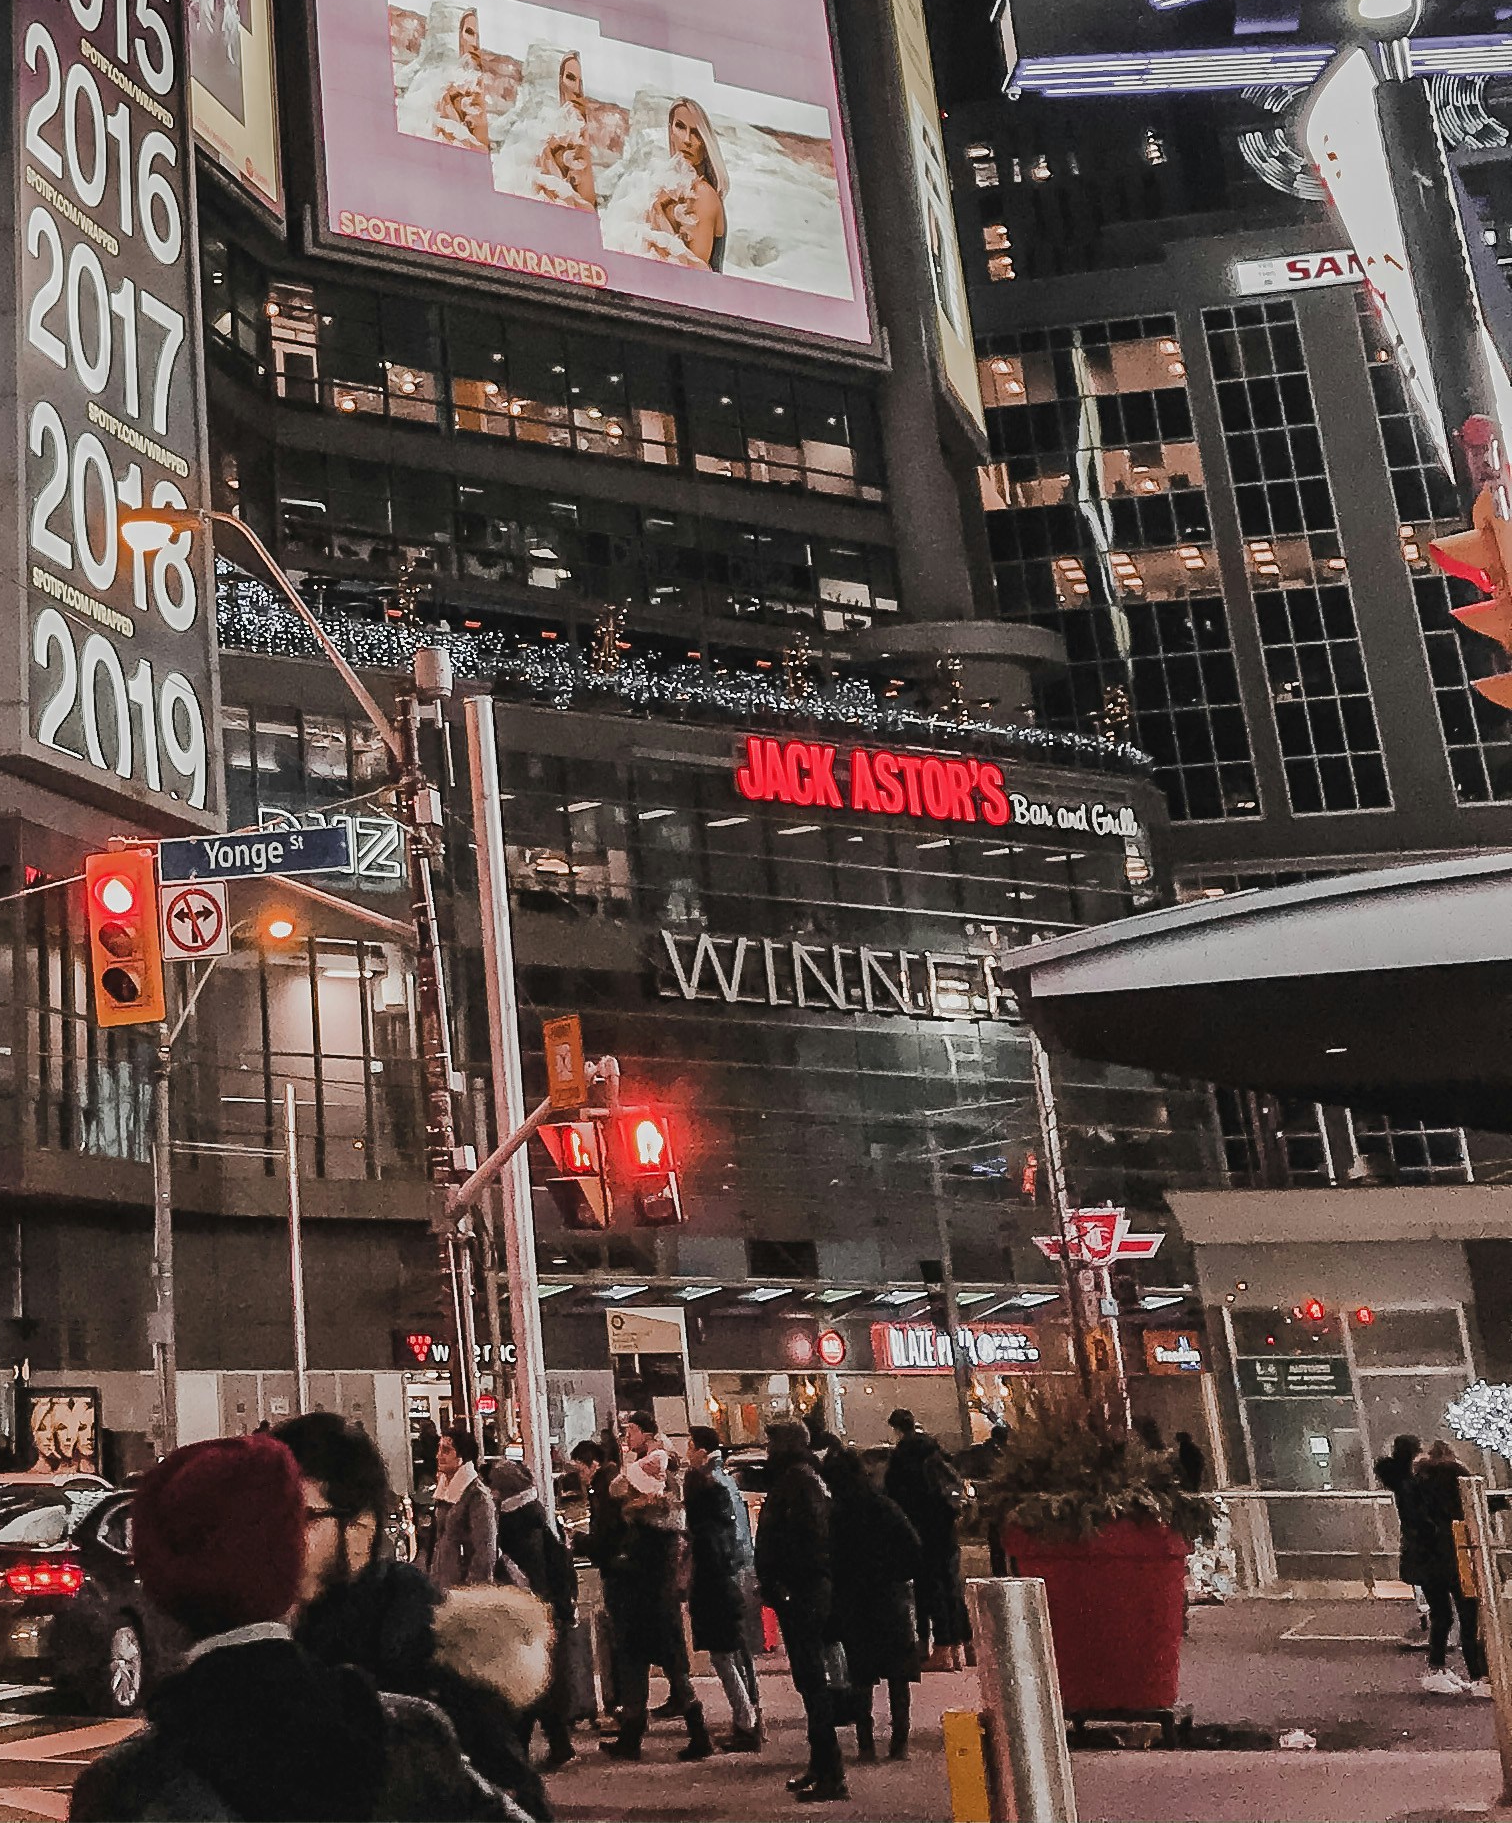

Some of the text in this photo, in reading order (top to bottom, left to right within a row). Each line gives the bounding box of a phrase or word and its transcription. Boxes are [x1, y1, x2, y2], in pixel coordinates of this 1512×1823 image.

[24, 22, 183, 265] 2016
[27, 206, 185, 437] 2017
[337, 209, 609, 288] SPOTIFY.COM/WRAPPED
[29, 400, 198, 633] 2018
[33, 607, 208, 811] 2019
[737, 735, 1012, 826] JACK ASTOR'S
[204, 835, 304, 873] Yonge St
[1009, 793, 1139, 838] Bar and Grill
